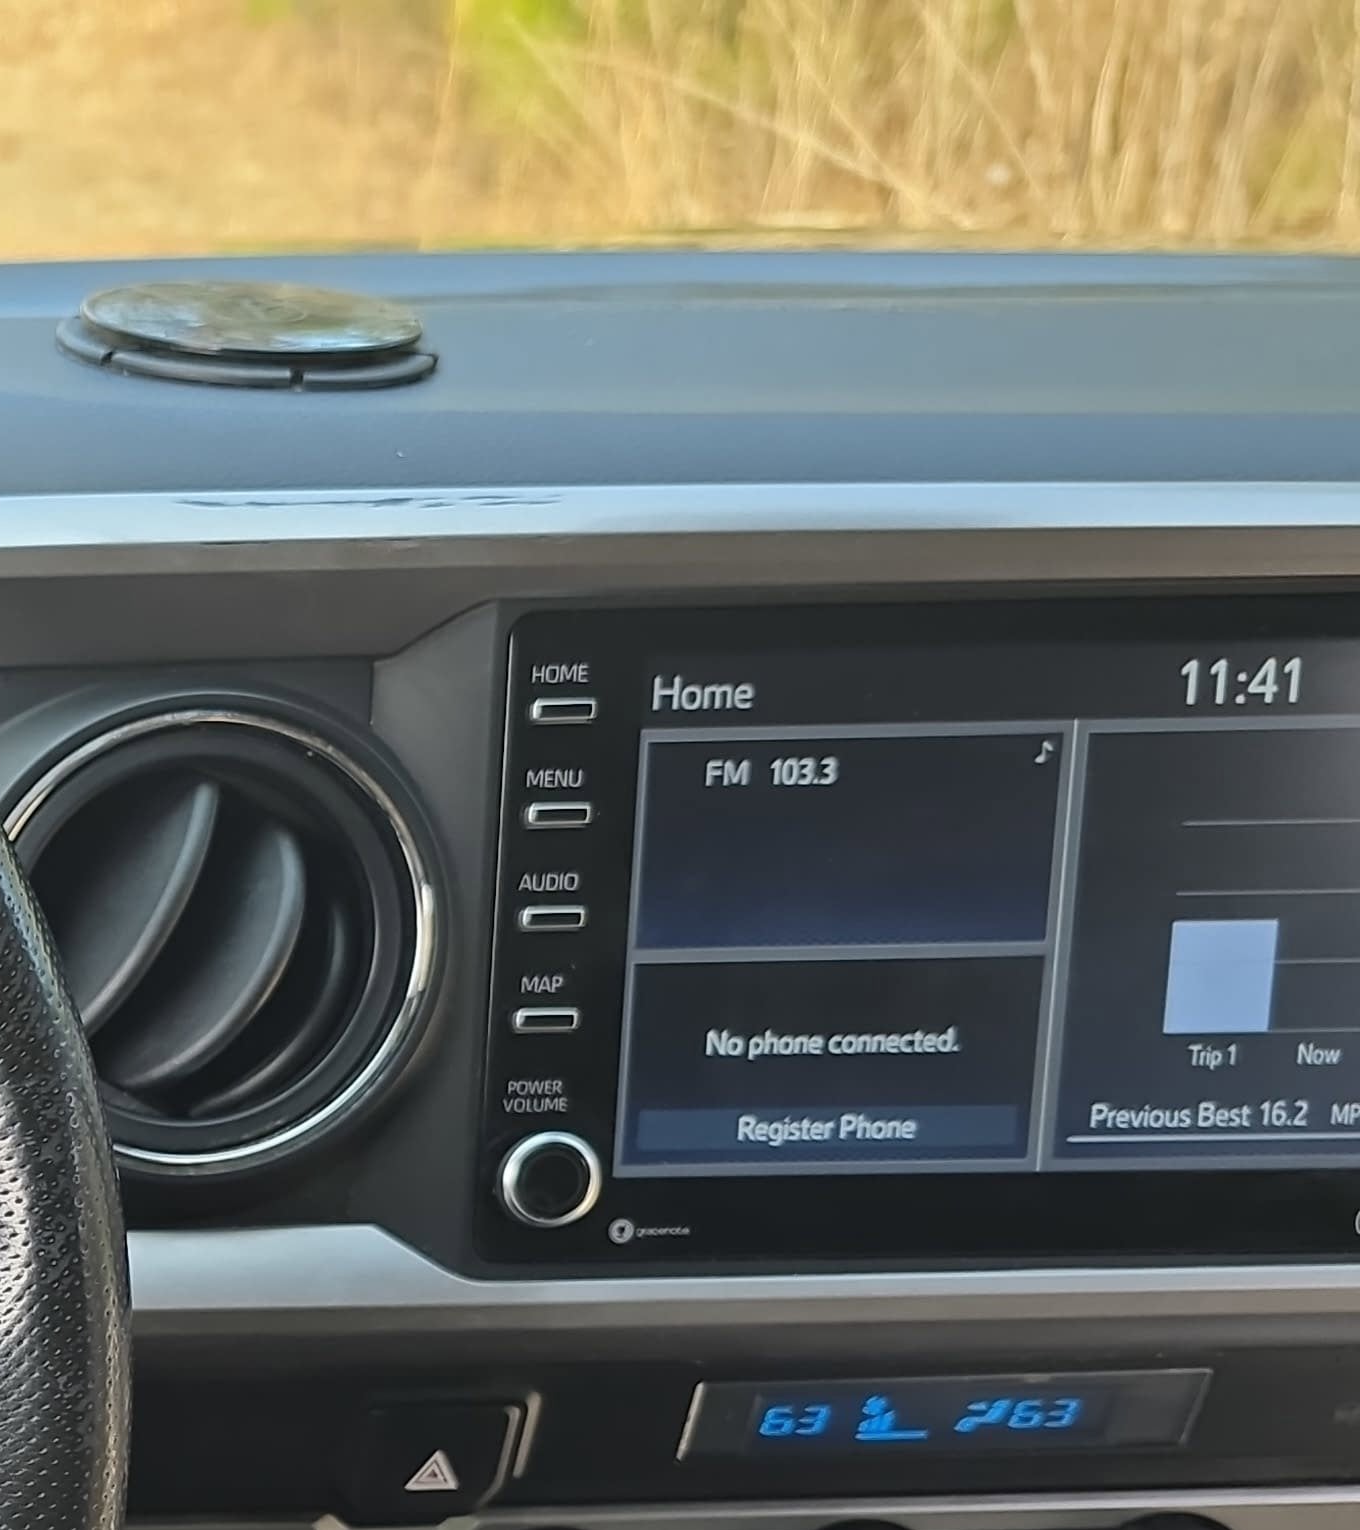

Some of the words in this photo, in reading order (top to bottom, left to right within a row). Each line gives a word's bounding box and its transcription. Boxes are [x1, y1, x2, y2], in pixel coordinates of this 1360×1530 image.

[531, 664, 589, 684] HOME
[1180, 656, 1303, 705] 11:41
[651, 676, 755, 711] Home
[526, 769, 584, 788] MENU
[704, 759, 751, 786] FM
[769, 757, 839, 786] 103.3
[518, 873, 579, 892] AUDIO
[520, 975, 564, 994] MAP
[705, 1029, 744, 1057] No
[747, 1028, 823, 1060] phone
[827, 1026, 962, 1056] connected.
[1297, 1043, 1341, 1065] Now
[1188, 1044, 1223, 1070] Trip
[1227, 1044, 1237, 1065] 1
[507, 1080, 562, 1096] POWER
[502, 1096, 568, 1114] VOLUME
[1089, 1102, 1191, 1129] Previous
[1196, 1102, 1251, 1128] Best
[1260, 1100, 1308, 1126] 16.2
[736, 1113, 834, 1146] Register
[839, 1112, 917, 1140] Phone
[759, 1404, 831, 1436] 63
[1007, 1399, 1080, 1430] 63
